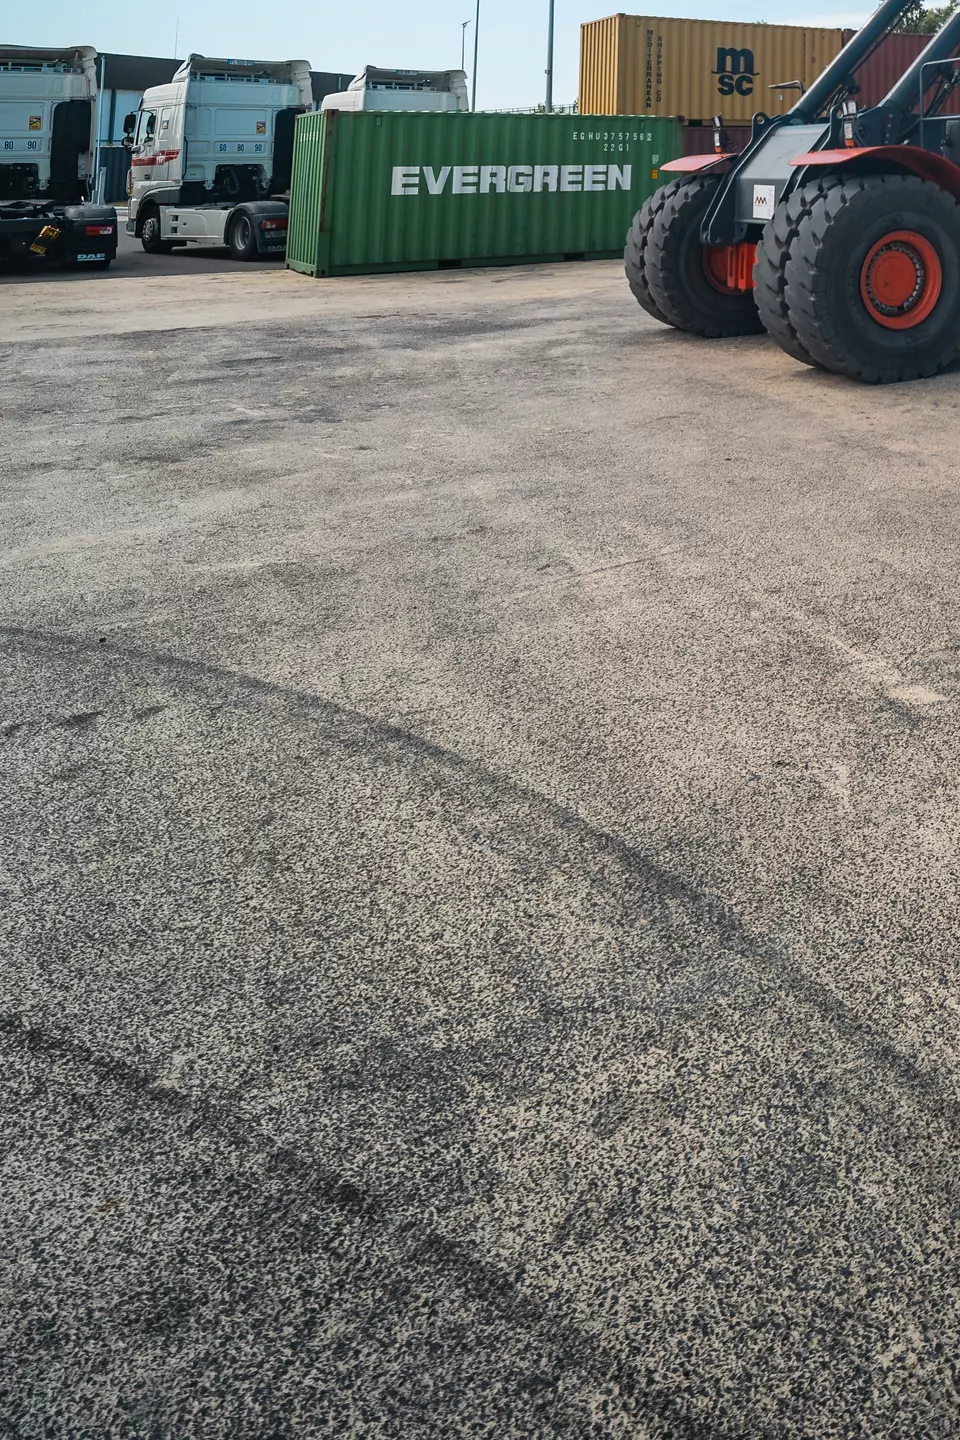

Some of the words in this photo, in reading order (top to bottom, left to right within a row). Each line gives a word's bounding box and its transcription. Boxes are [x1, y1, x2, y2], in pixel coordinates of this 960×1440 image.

[646, 29, 654, 108] MEDITERRANEAN
[656, 89, 662, 103] CO
[4, 140, 14, 150] 80
[27, 140, 37, 150] 90
[219, 143, 227, 152] 60
[236, 143, 245, 152] 80
[254, 143, 263, 152] 90
[390, 164, 632, 196] EVERGREEN
[77, 252, 106, 260] DAF
